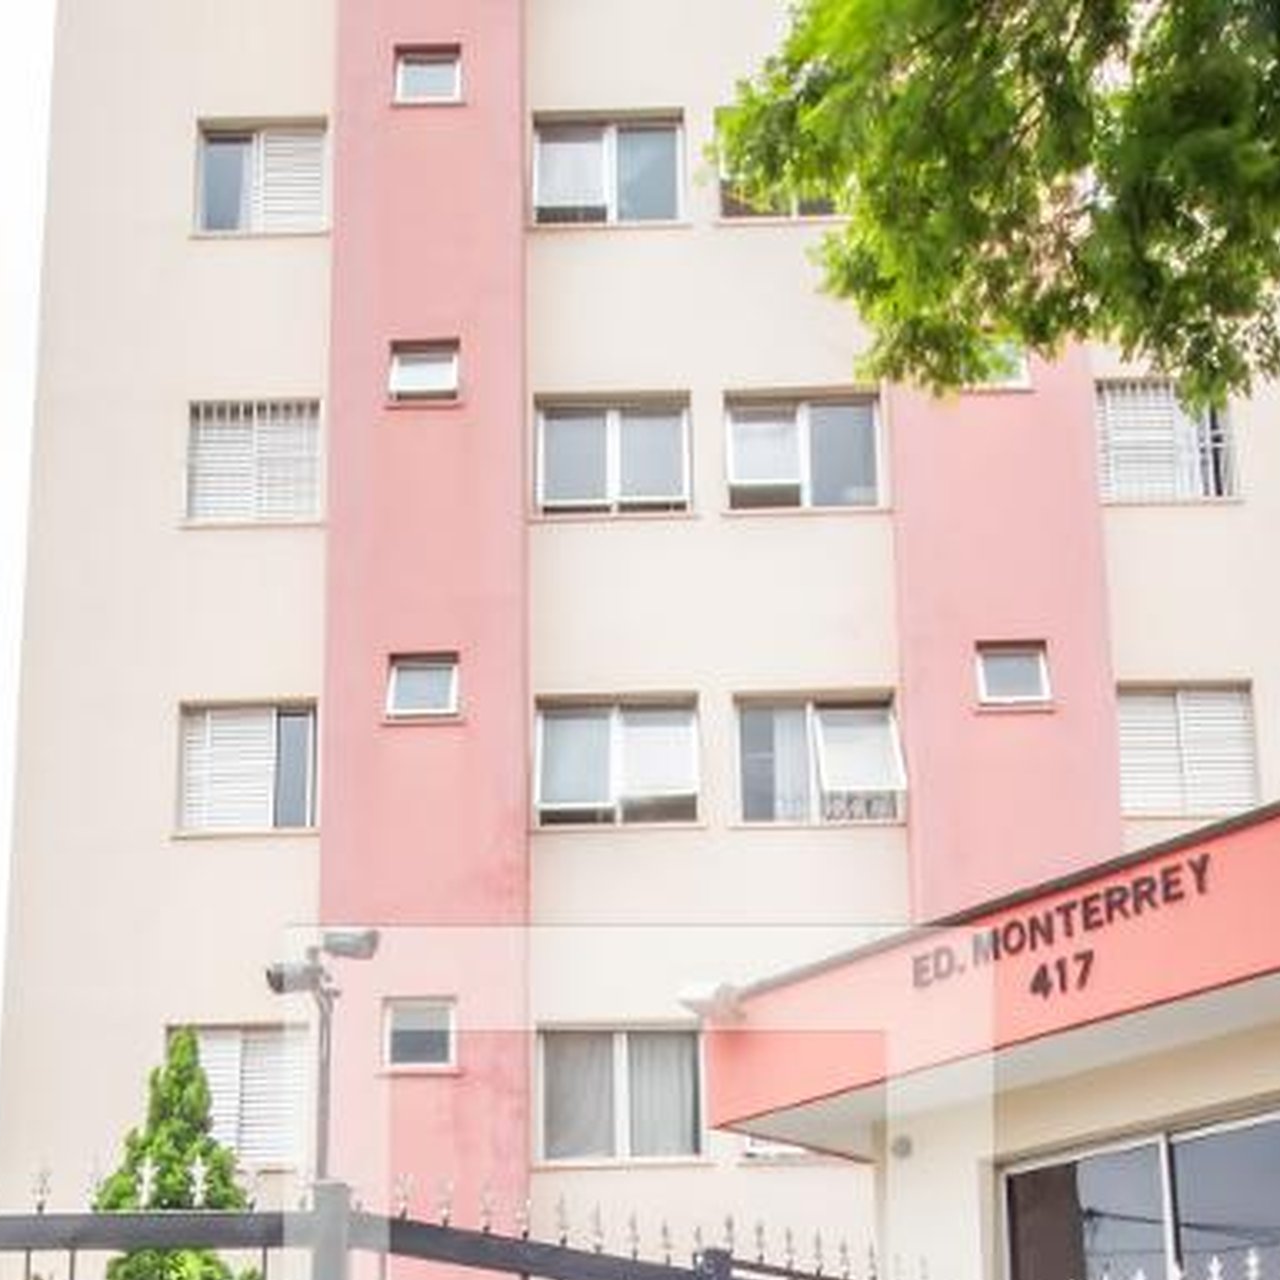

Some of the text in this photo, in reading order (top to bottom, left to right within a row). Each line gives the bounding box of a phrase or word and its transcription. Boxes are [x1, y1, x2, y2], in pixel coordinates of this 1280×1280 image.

[912, 853, 1211, 988] ED. MONTERREY
[1029, 951, 1095, 1000] 417
